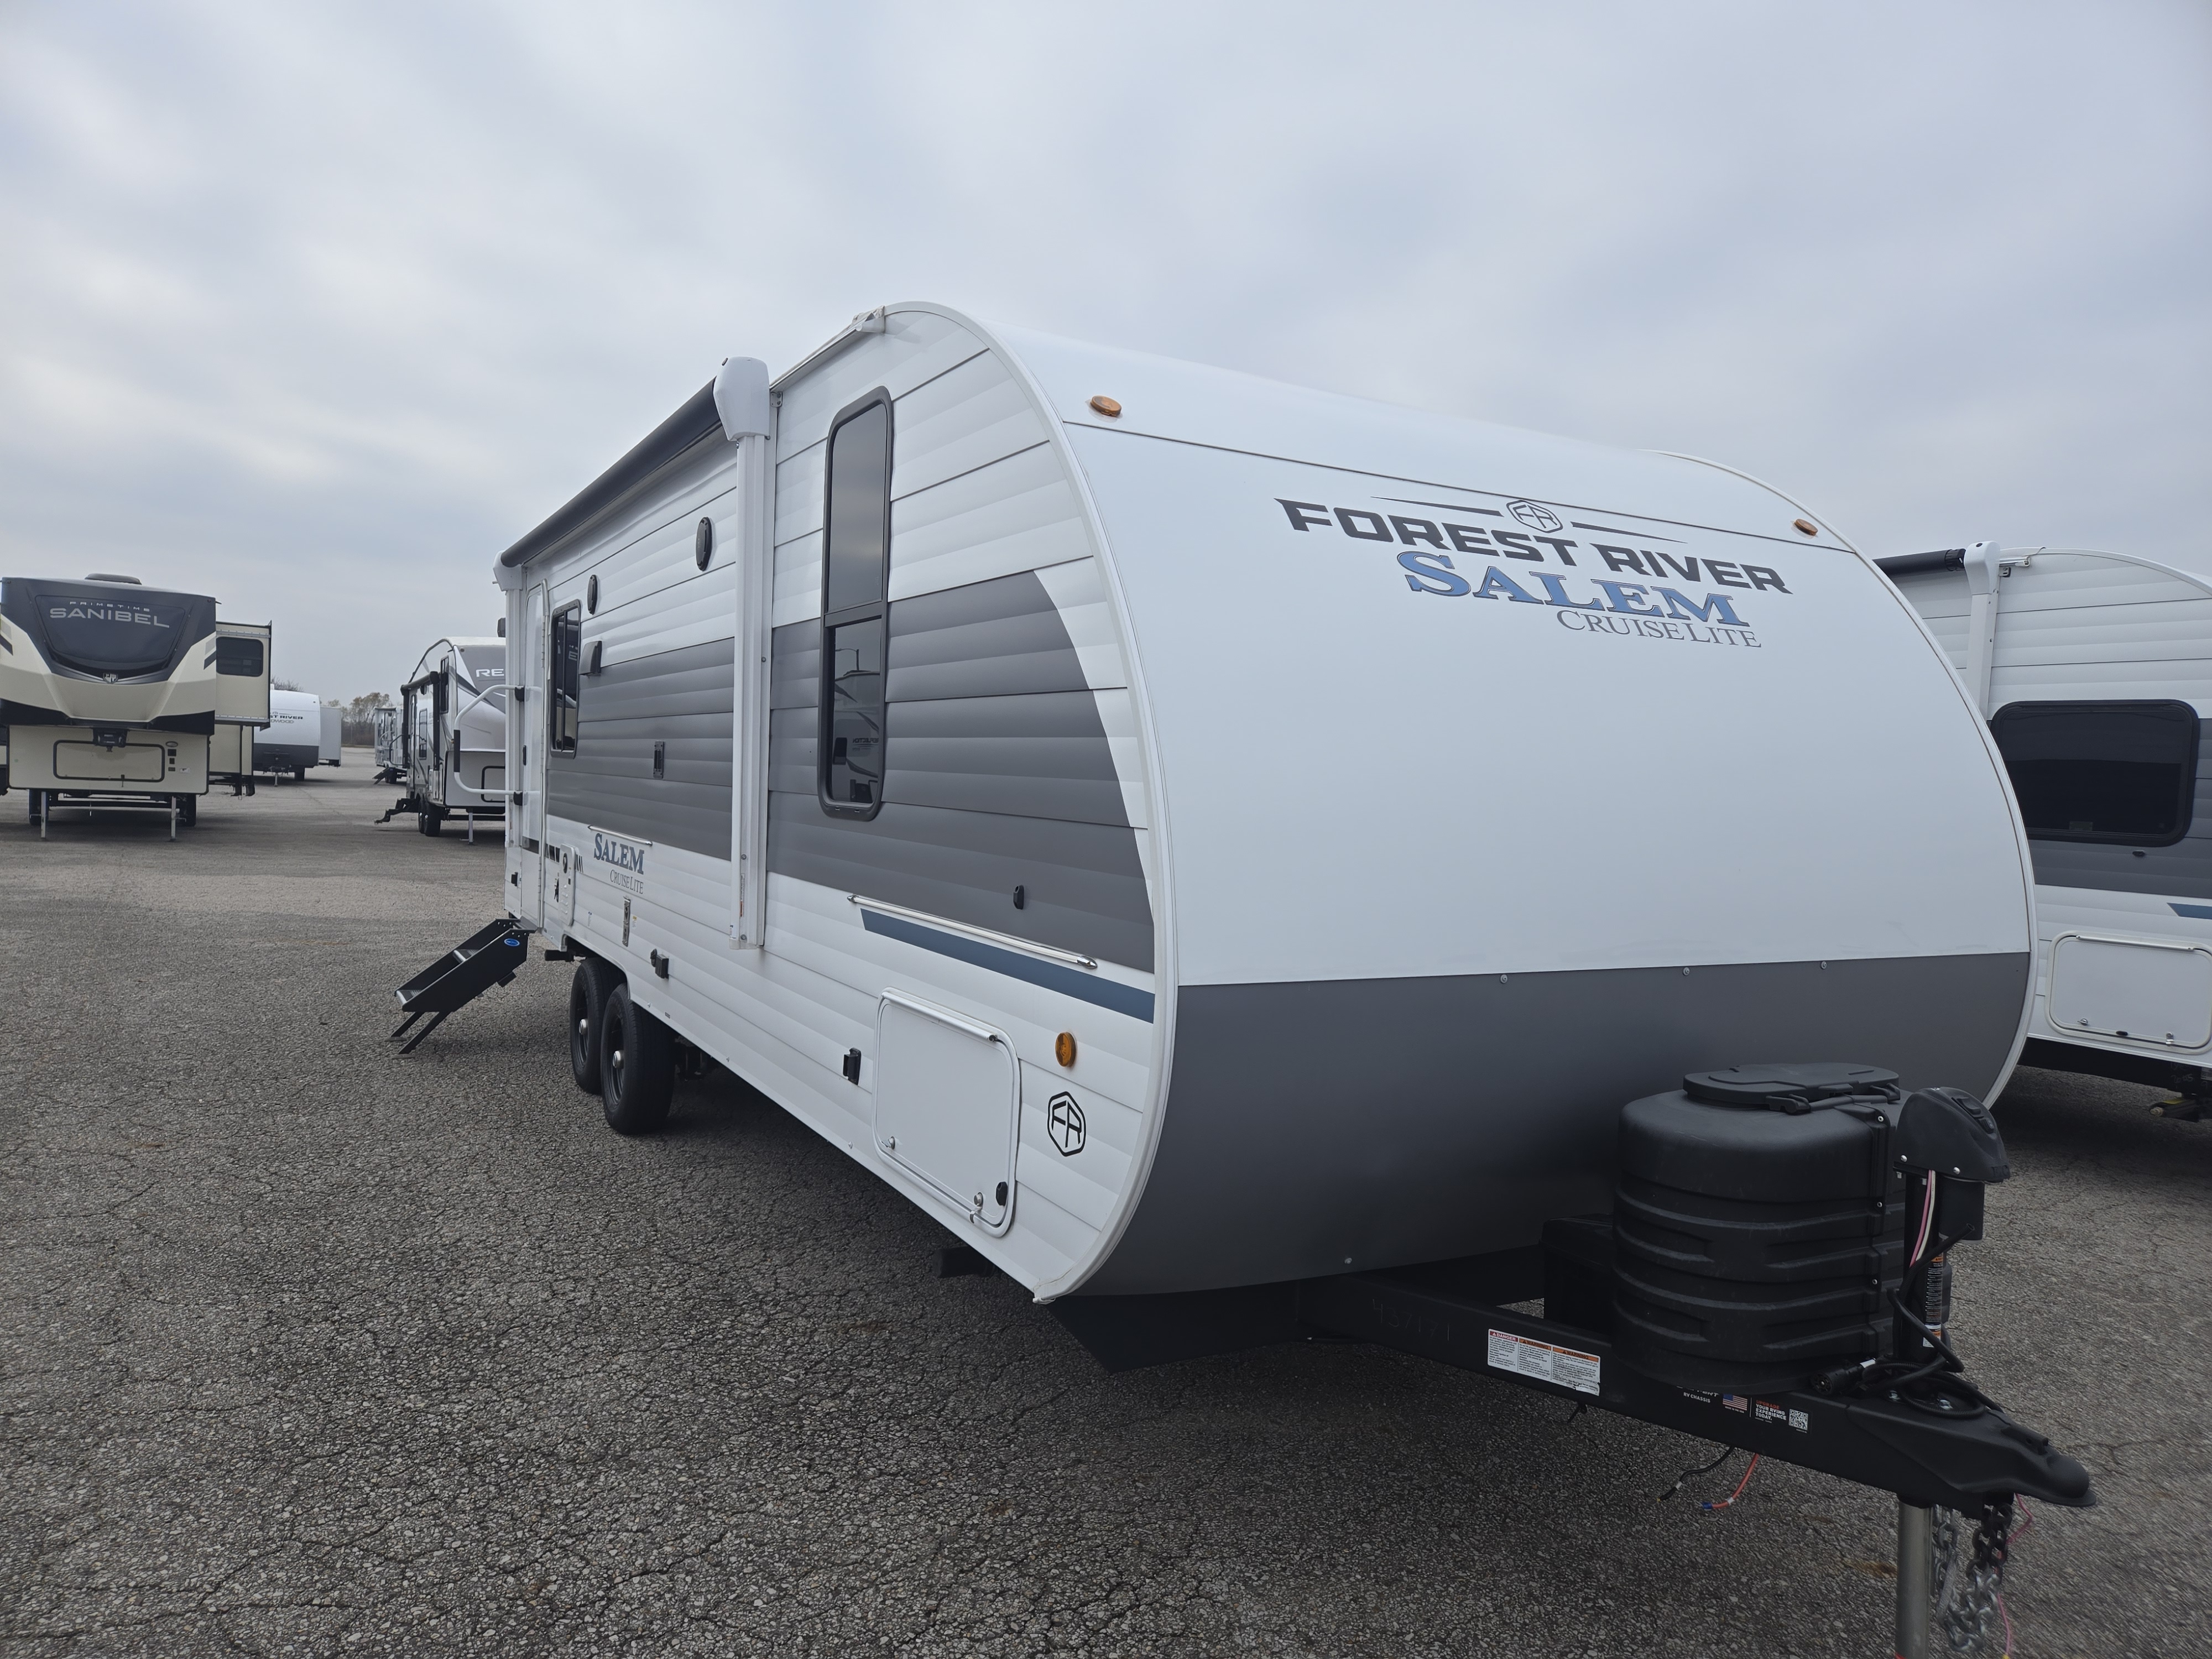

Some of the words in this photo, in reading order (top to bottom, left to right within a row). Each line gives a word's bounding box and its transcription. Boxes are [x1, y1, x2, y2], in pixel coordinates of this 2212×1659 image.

[1274, 498, 1577, 567] FOREST
[1590, 542, 1793, 595] RIVER
[1397, 551, 1750, 628] SALEM
[50, 608, 170, 628] SANIBEL
[594, 833, 644, 875] SALEM
[610, 869, 644, 894] CRUISELITE
[1496, 1333, 1516, 1342] DANGER
[1527, 1340, 1548, 1349] WARNING
[1567, 1350, 1589, 1359] WARNING
[1690, 1394, 1711, 1404] CHASSIS
[1756, 1399, 1780, 1410] UPGRADE
[1755, 1407, 1787, 1421] EXPERIENCE
[1755, 1412, 1772, 1421] TODAY.
